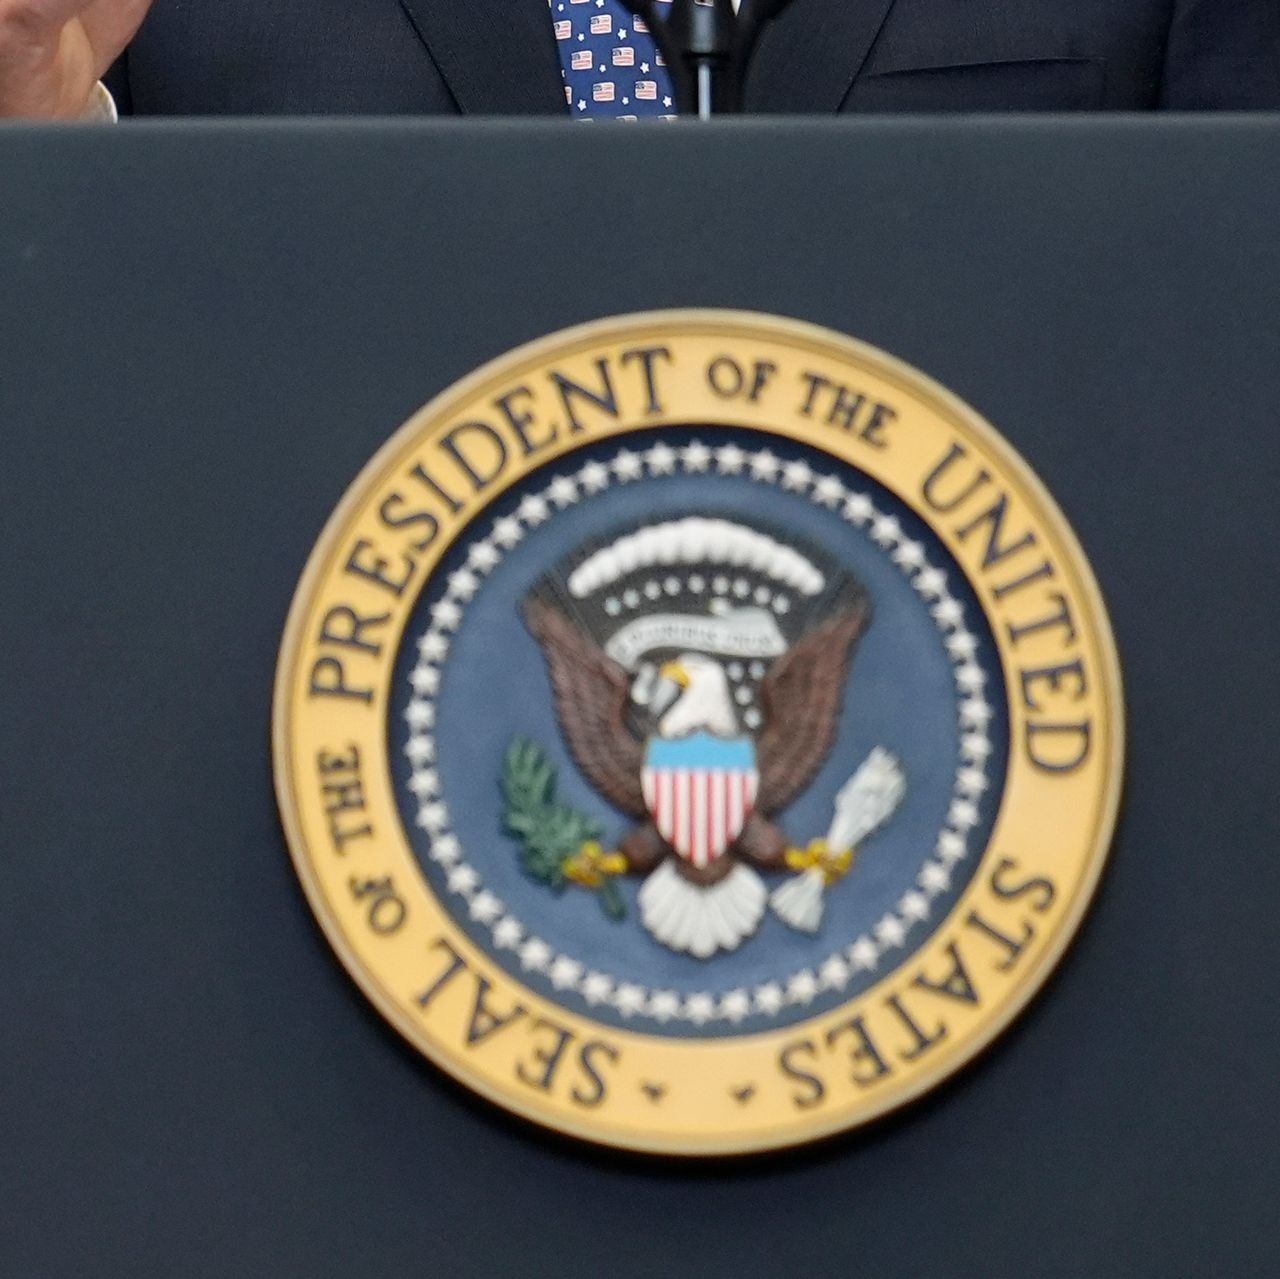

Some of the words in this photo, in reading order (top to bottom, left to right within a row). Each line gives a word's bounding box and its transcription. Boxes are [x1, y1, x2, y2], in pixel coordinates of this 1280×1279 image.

[707, 357, 777, 402] OF
[801, 373, 898, 449] THE
[309, 346, 674, 705] PRESIDENT
[923, 444, 1090, 774] UNITED
[318, 744, 373, 853] THE
[350, 875, 406, 935] OF
[416, 940, 621, 1106] SEAL
[780, 860, 1055, 1106] STATES
